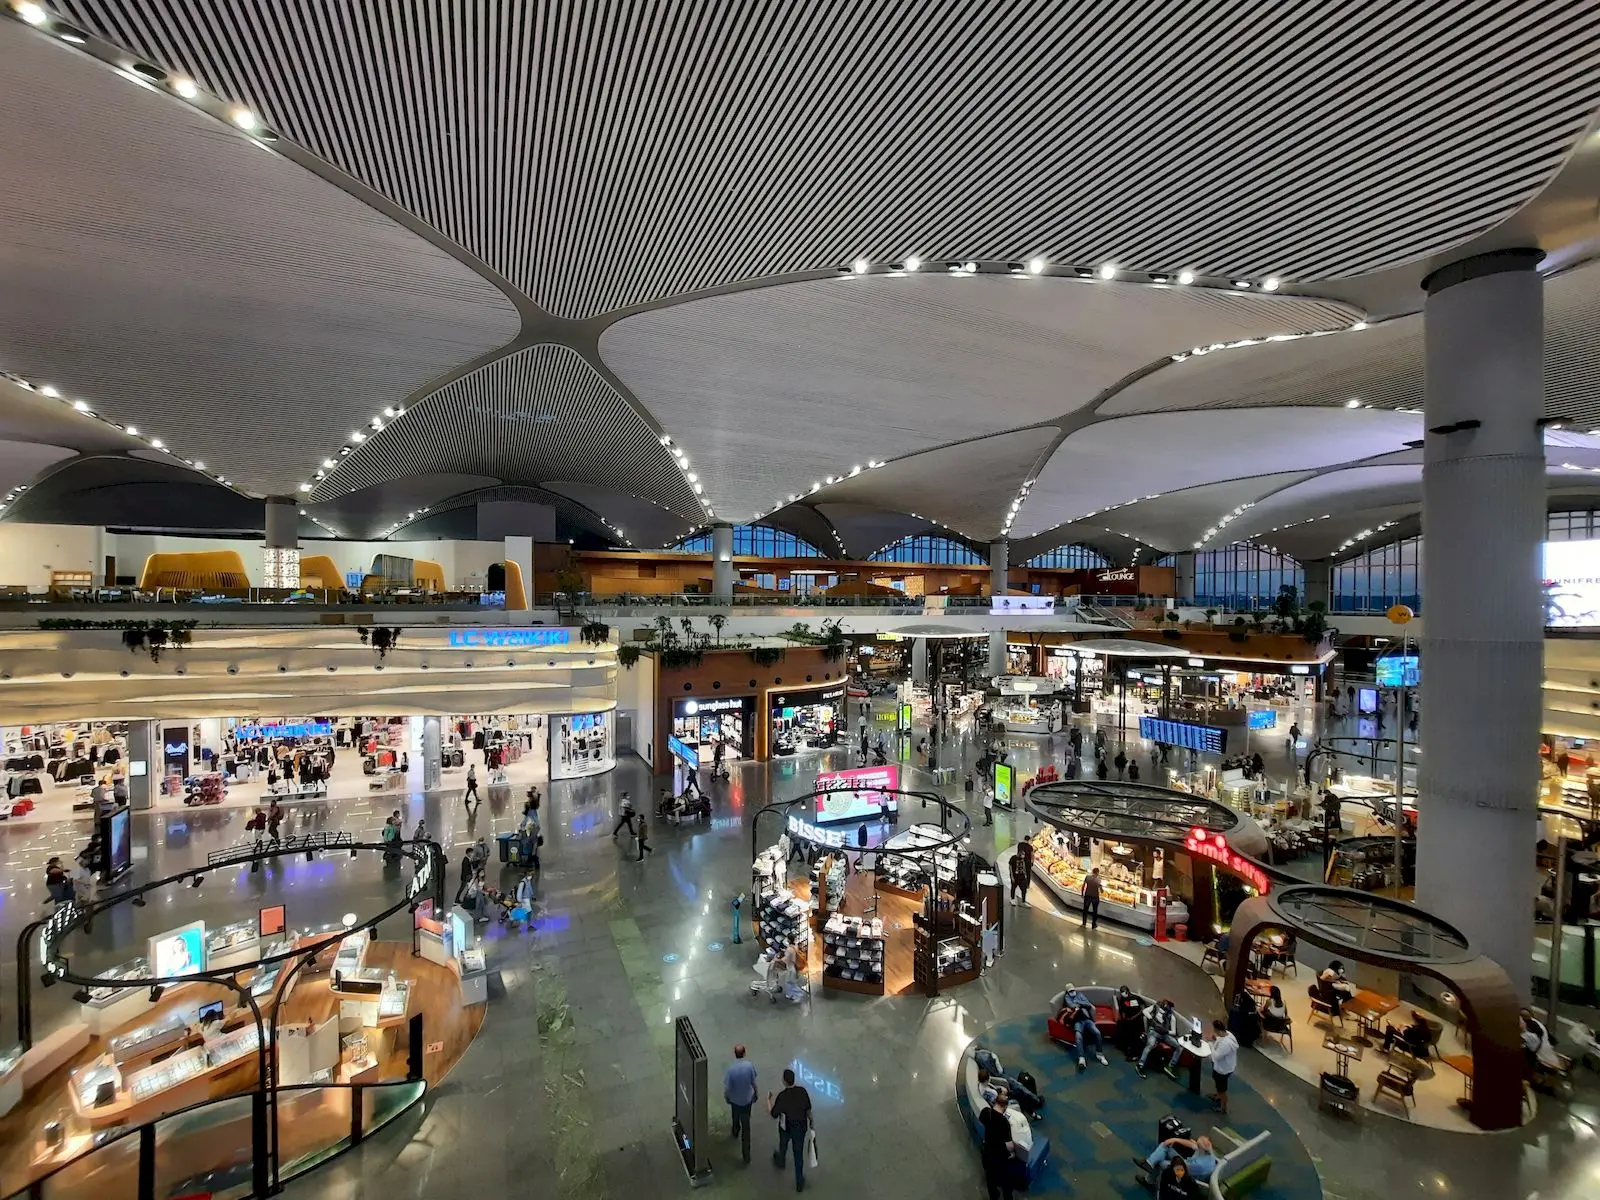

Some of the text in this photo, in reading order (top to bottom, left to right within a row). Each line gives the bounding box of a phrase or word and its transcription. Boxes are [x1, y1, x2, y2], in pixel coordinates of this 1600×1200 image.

[450, 630, 479, 647] LC
[698, 699, 743, 712] sunglass hut
